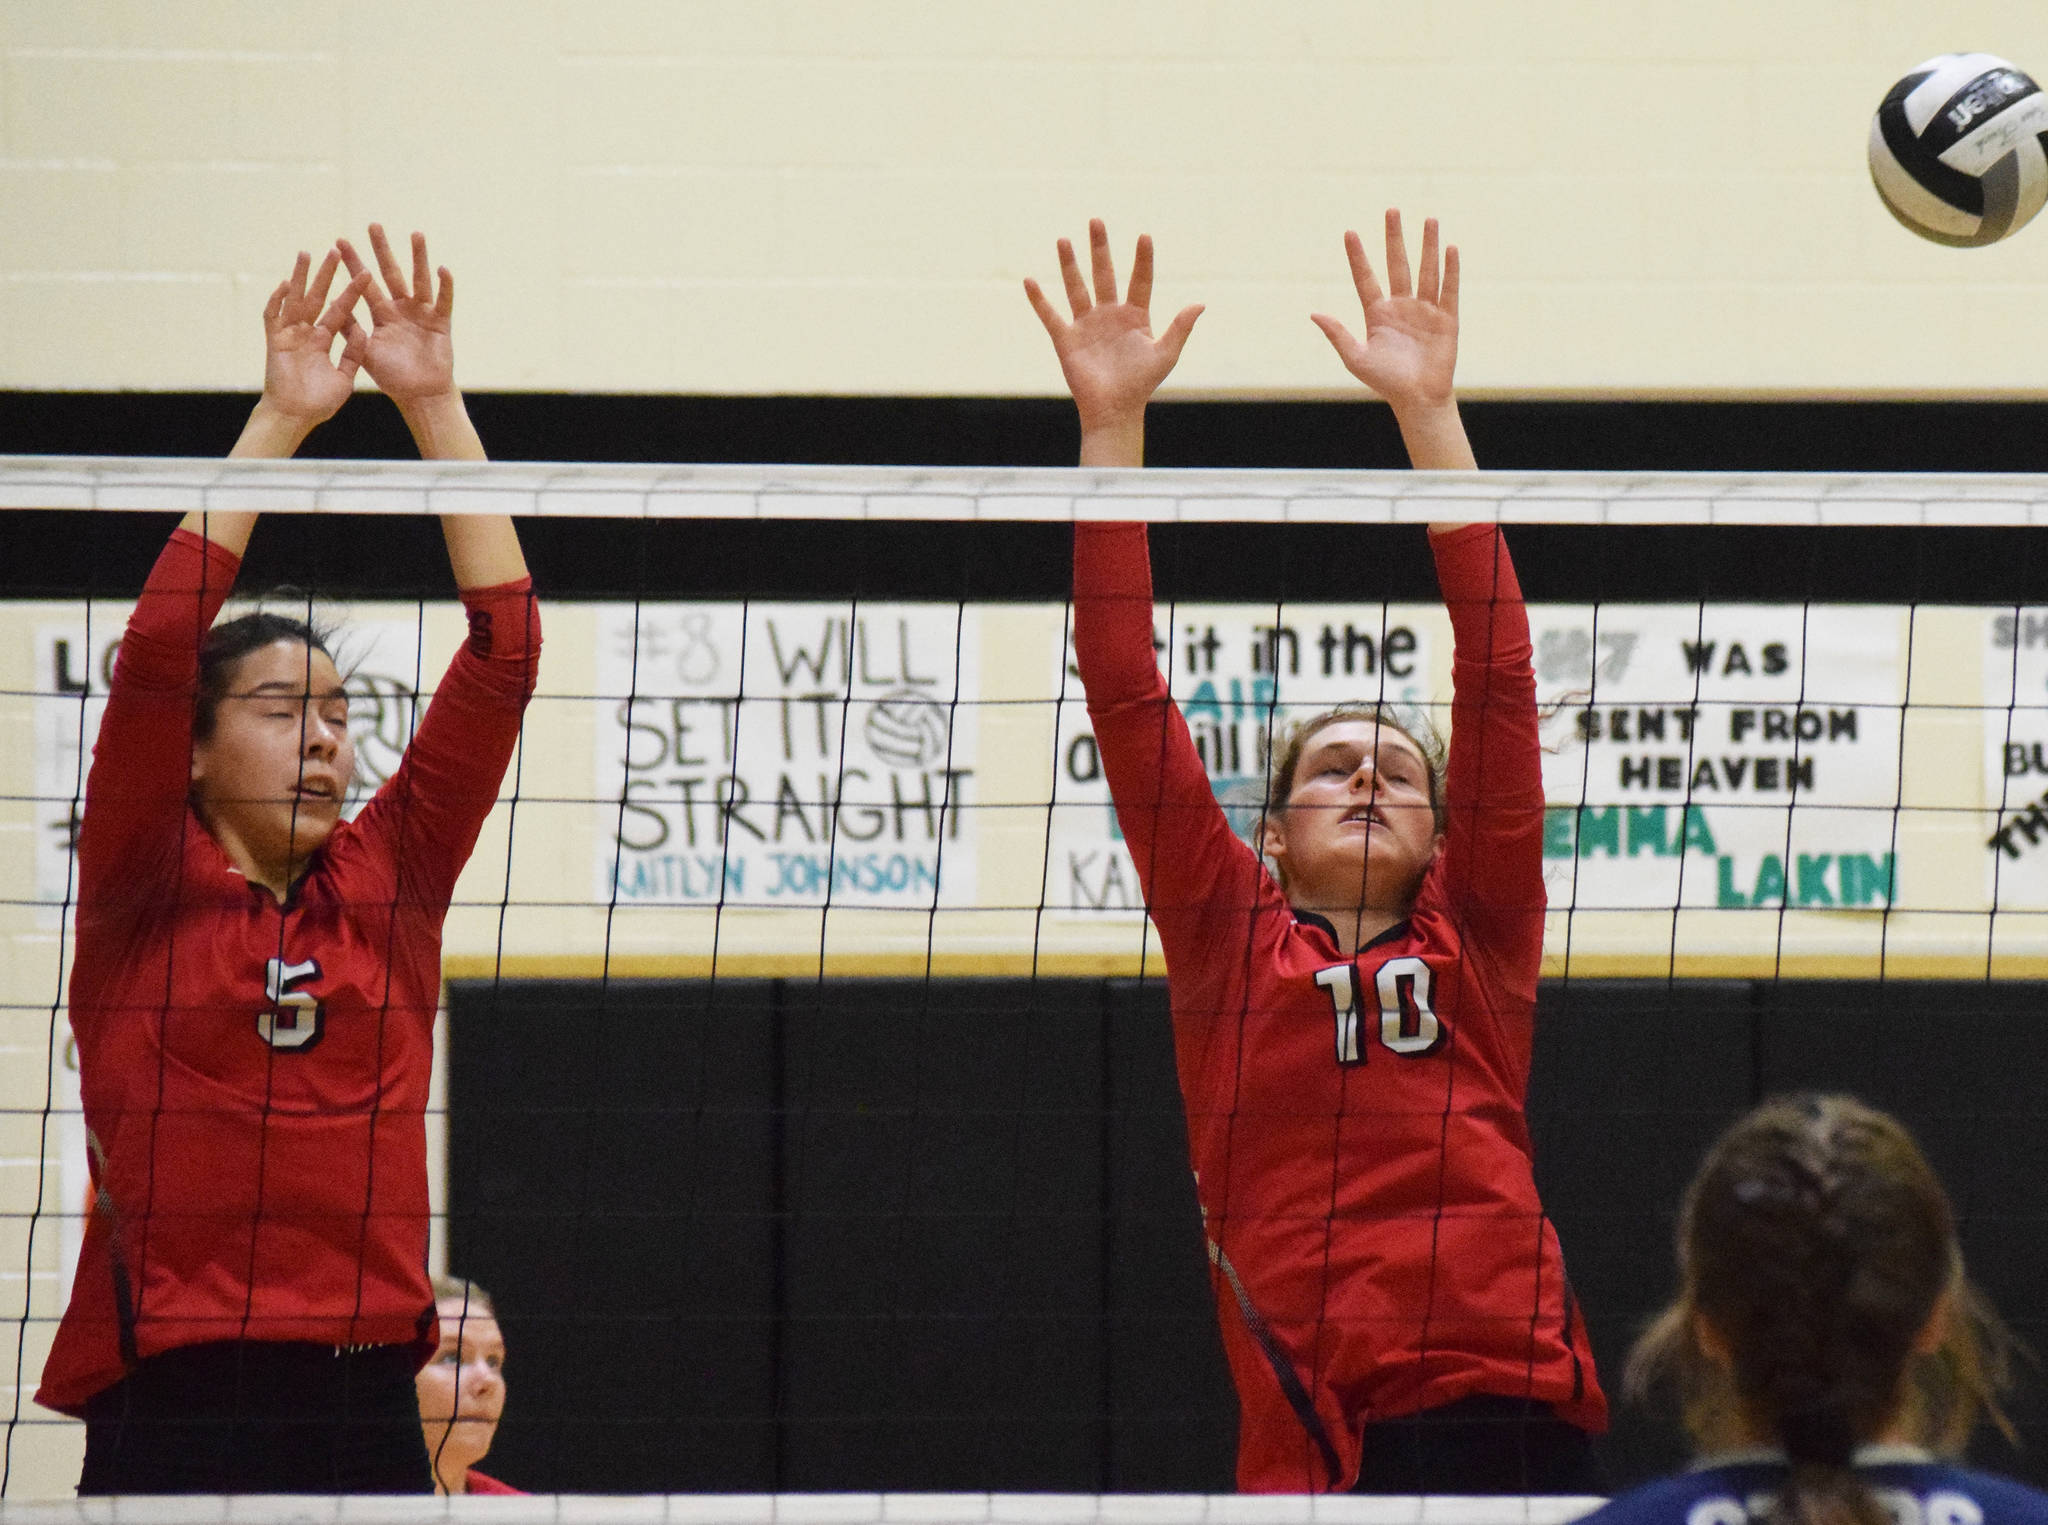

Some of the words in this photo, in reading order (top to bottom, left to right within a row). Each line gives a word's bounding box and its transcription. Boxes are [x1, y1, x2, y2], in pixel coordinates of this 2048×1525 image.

[766, 617, 936, 687] WILL
[1185, 623, 1221, 674] it
[1252, 623, 1299, 675] in
[1319, 622, 1417, 678] the
[1682, 639, 1790, 677] WAS
[616, 695, 744, 771] SET
[780, 691, 837, 761] IT
[1576, 708, 1702, 742] SENT
[1731, 708, 1858, 743] FROM
[1620, 756, 1815, 792] HEAVEN
[613, 768, 973, 852] STRAIGHT
[1543, 804, 1717, 858] EMMA
[608, 853, 745, 897] KAITLYN
[767, 852, 943, 896] JOHNSON
[1717, 852, 1897, 911] LAKIN
[258, 957, 323, 1051] 5
[1315, 957, 1446, 1065] 10
